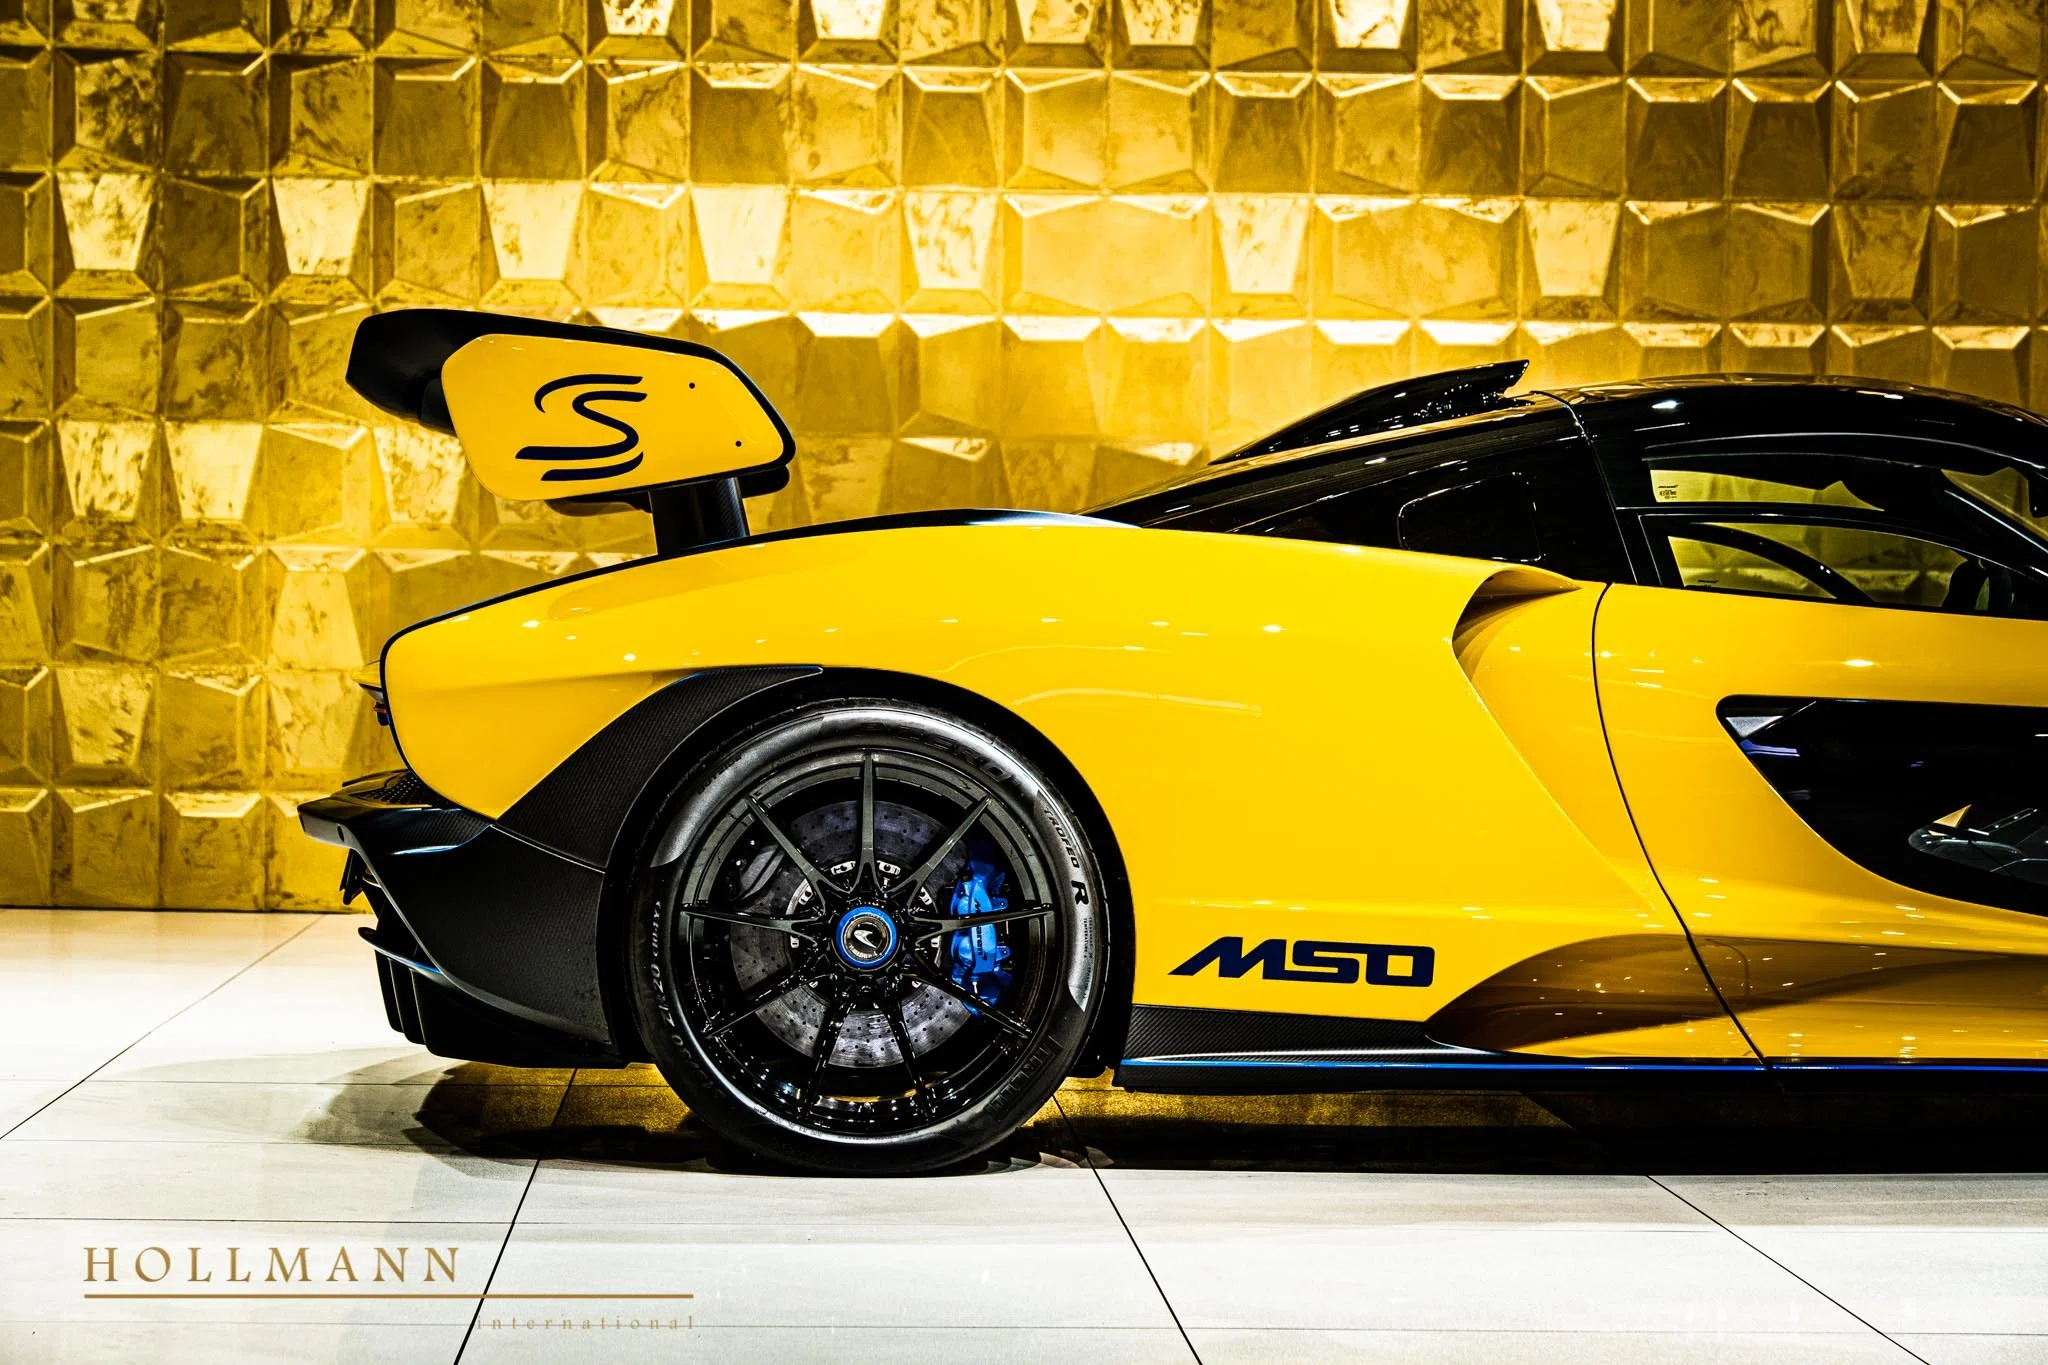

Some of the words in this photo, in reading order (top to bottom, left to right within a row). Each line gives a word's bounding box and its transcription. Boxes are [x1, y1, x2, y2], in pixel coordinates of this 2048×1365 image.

[1043, 807, 1080, 869] TROFEO
[1070, 879, 1089, 906] R
[973, 899, 983, 956] Maren
[1168, 936, 1435, 988] MSO
